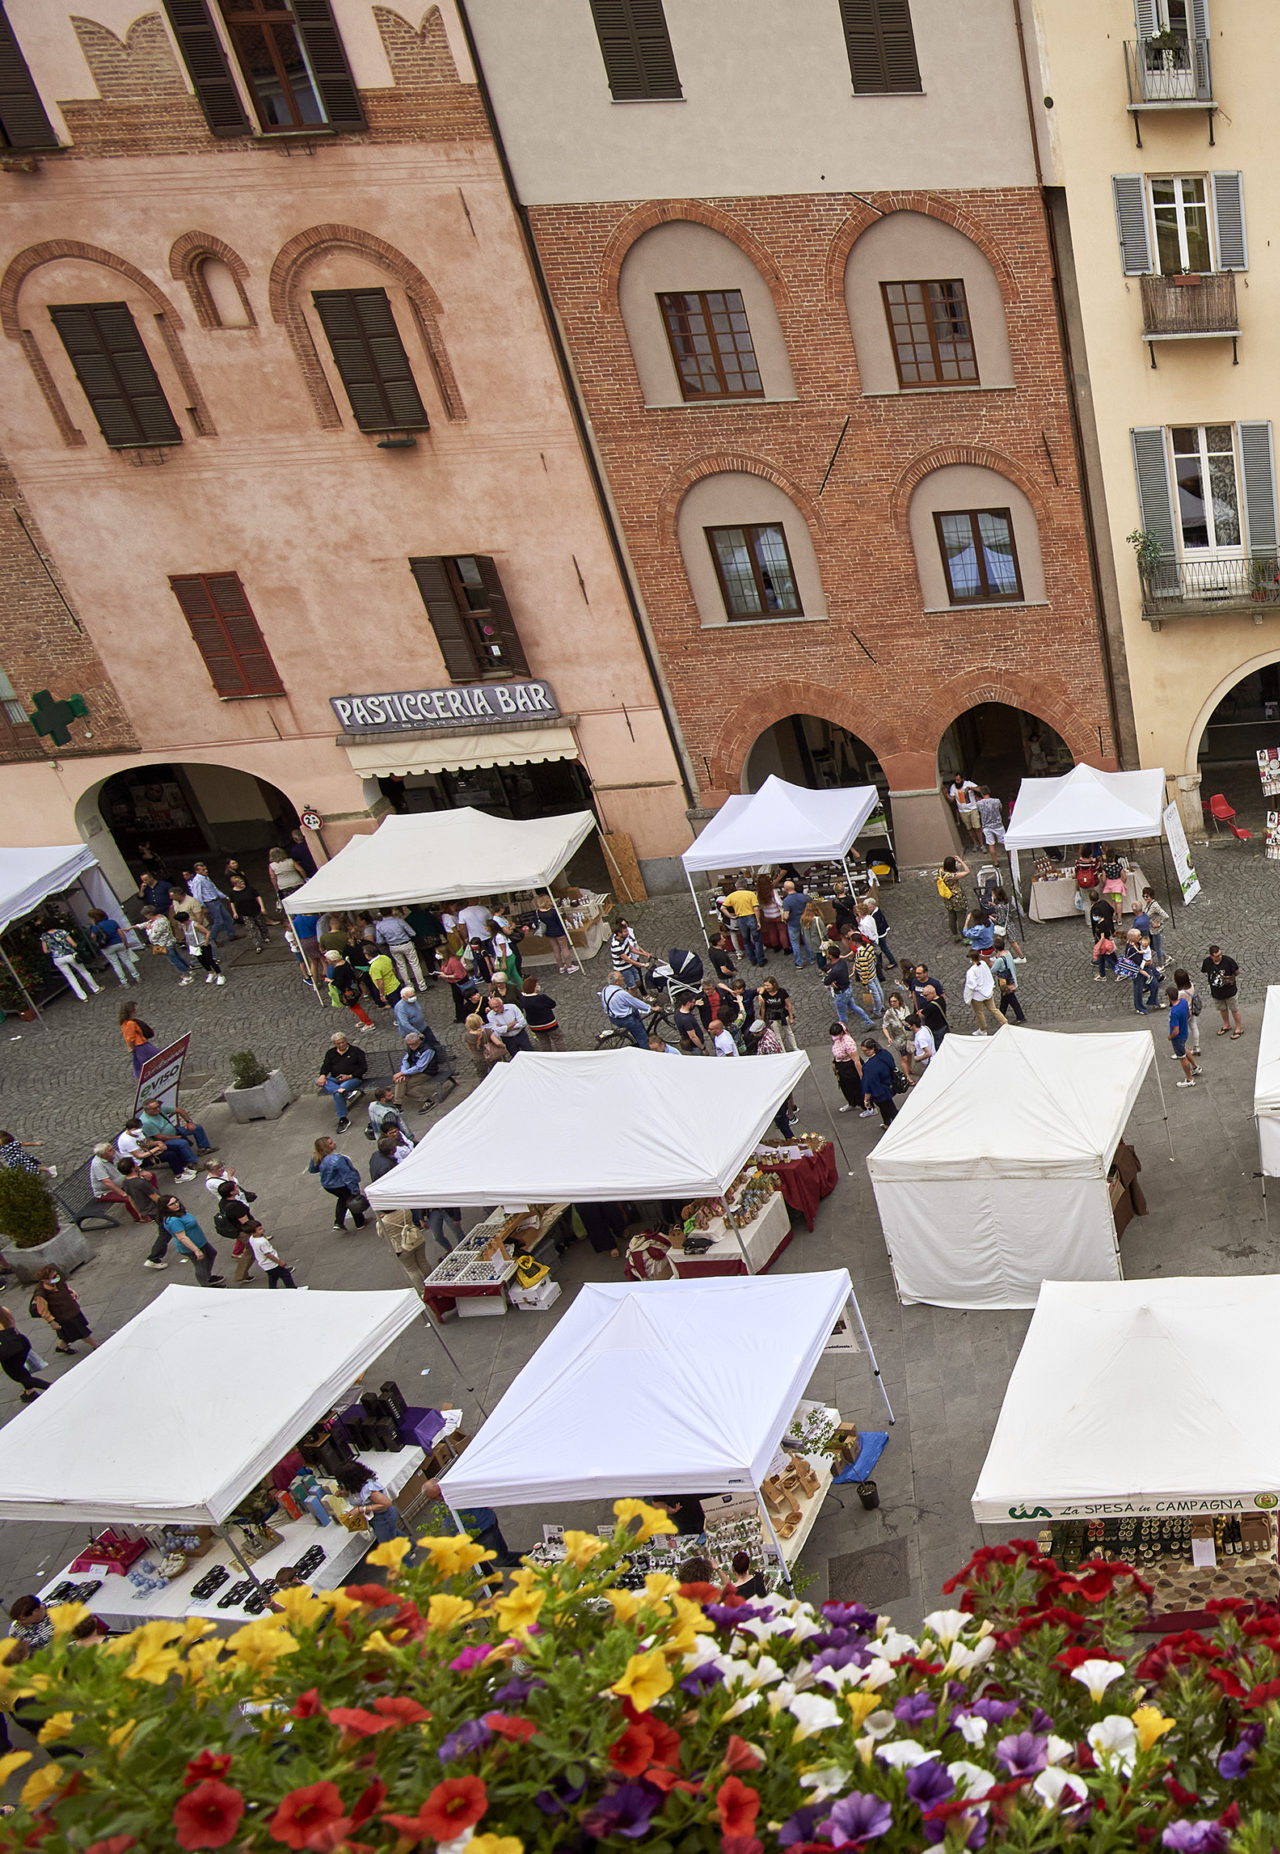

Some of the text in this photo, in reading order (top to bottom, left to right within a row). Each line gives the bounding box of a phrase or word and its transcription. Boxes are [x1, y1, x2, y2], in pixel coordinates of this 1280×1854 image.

[335, 683, 553, 726] PASTICCERIA BAR
[1060, 1499, 1244, 1515] La SPESA in CAMPAGNA
